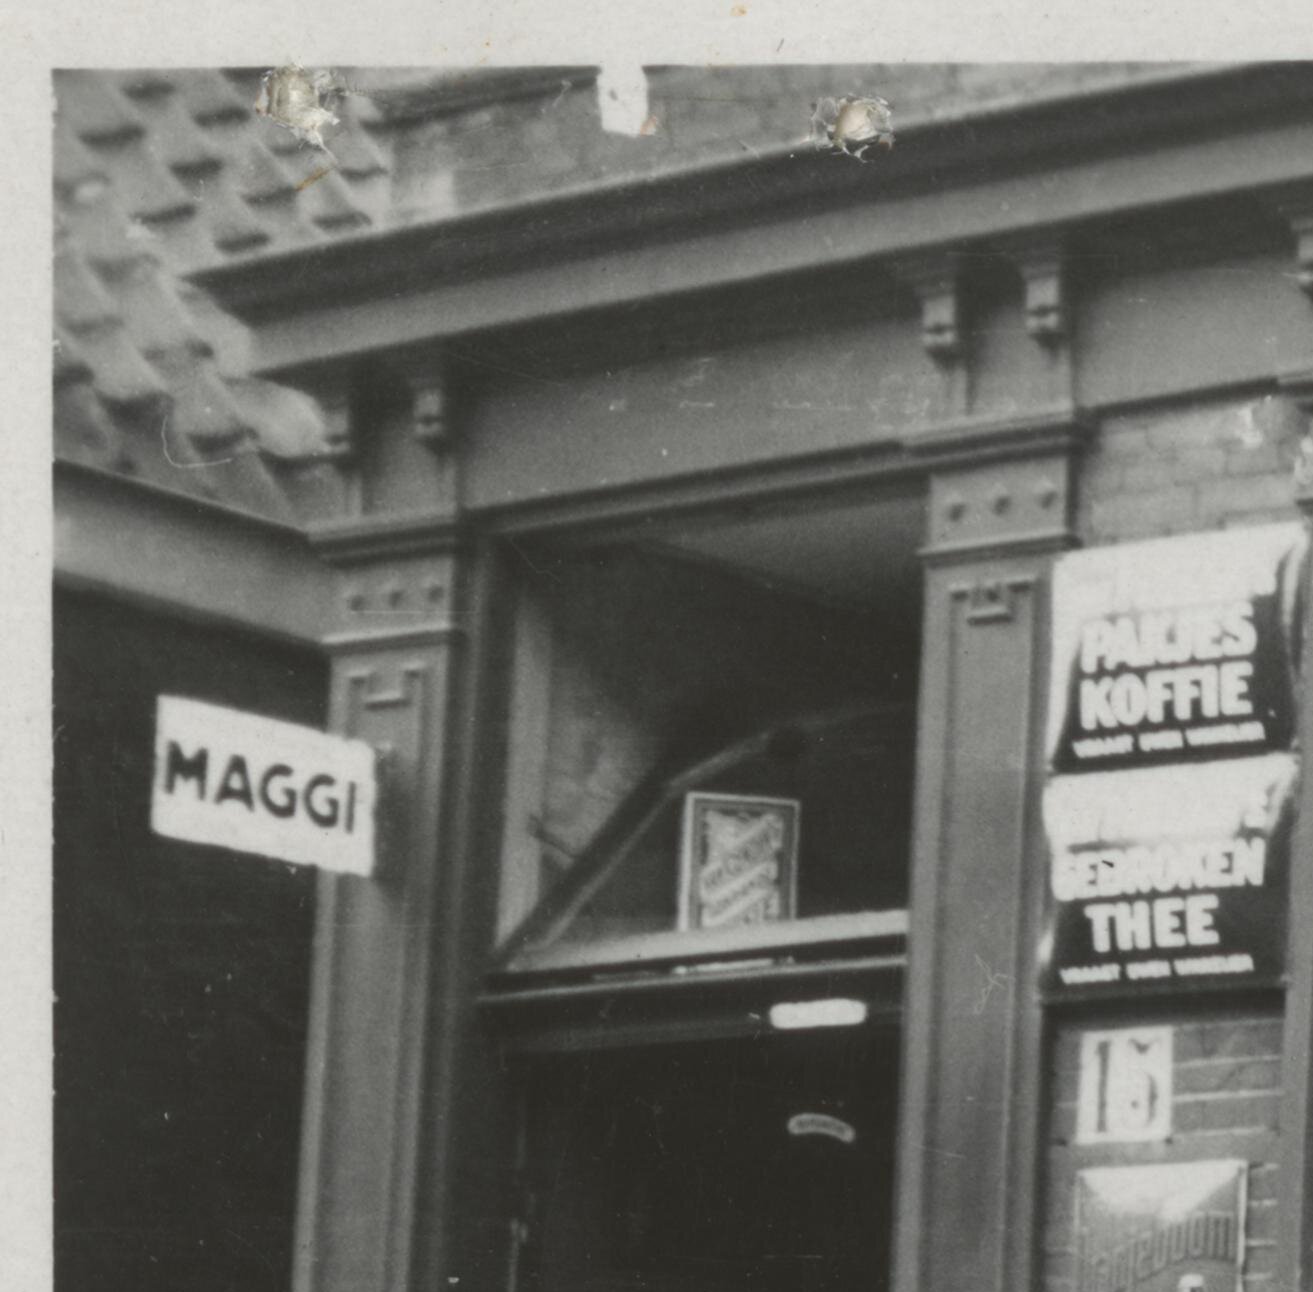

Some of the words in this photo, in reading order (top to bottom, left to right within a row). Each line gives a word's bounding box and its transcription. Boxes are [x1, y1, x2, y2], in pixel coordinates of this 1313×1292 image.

[1080, 662, 1253, 730] KOFFIE
[163, 740, 357, 834] MAGGI
[1084, 893, 1221, 952] THEE
